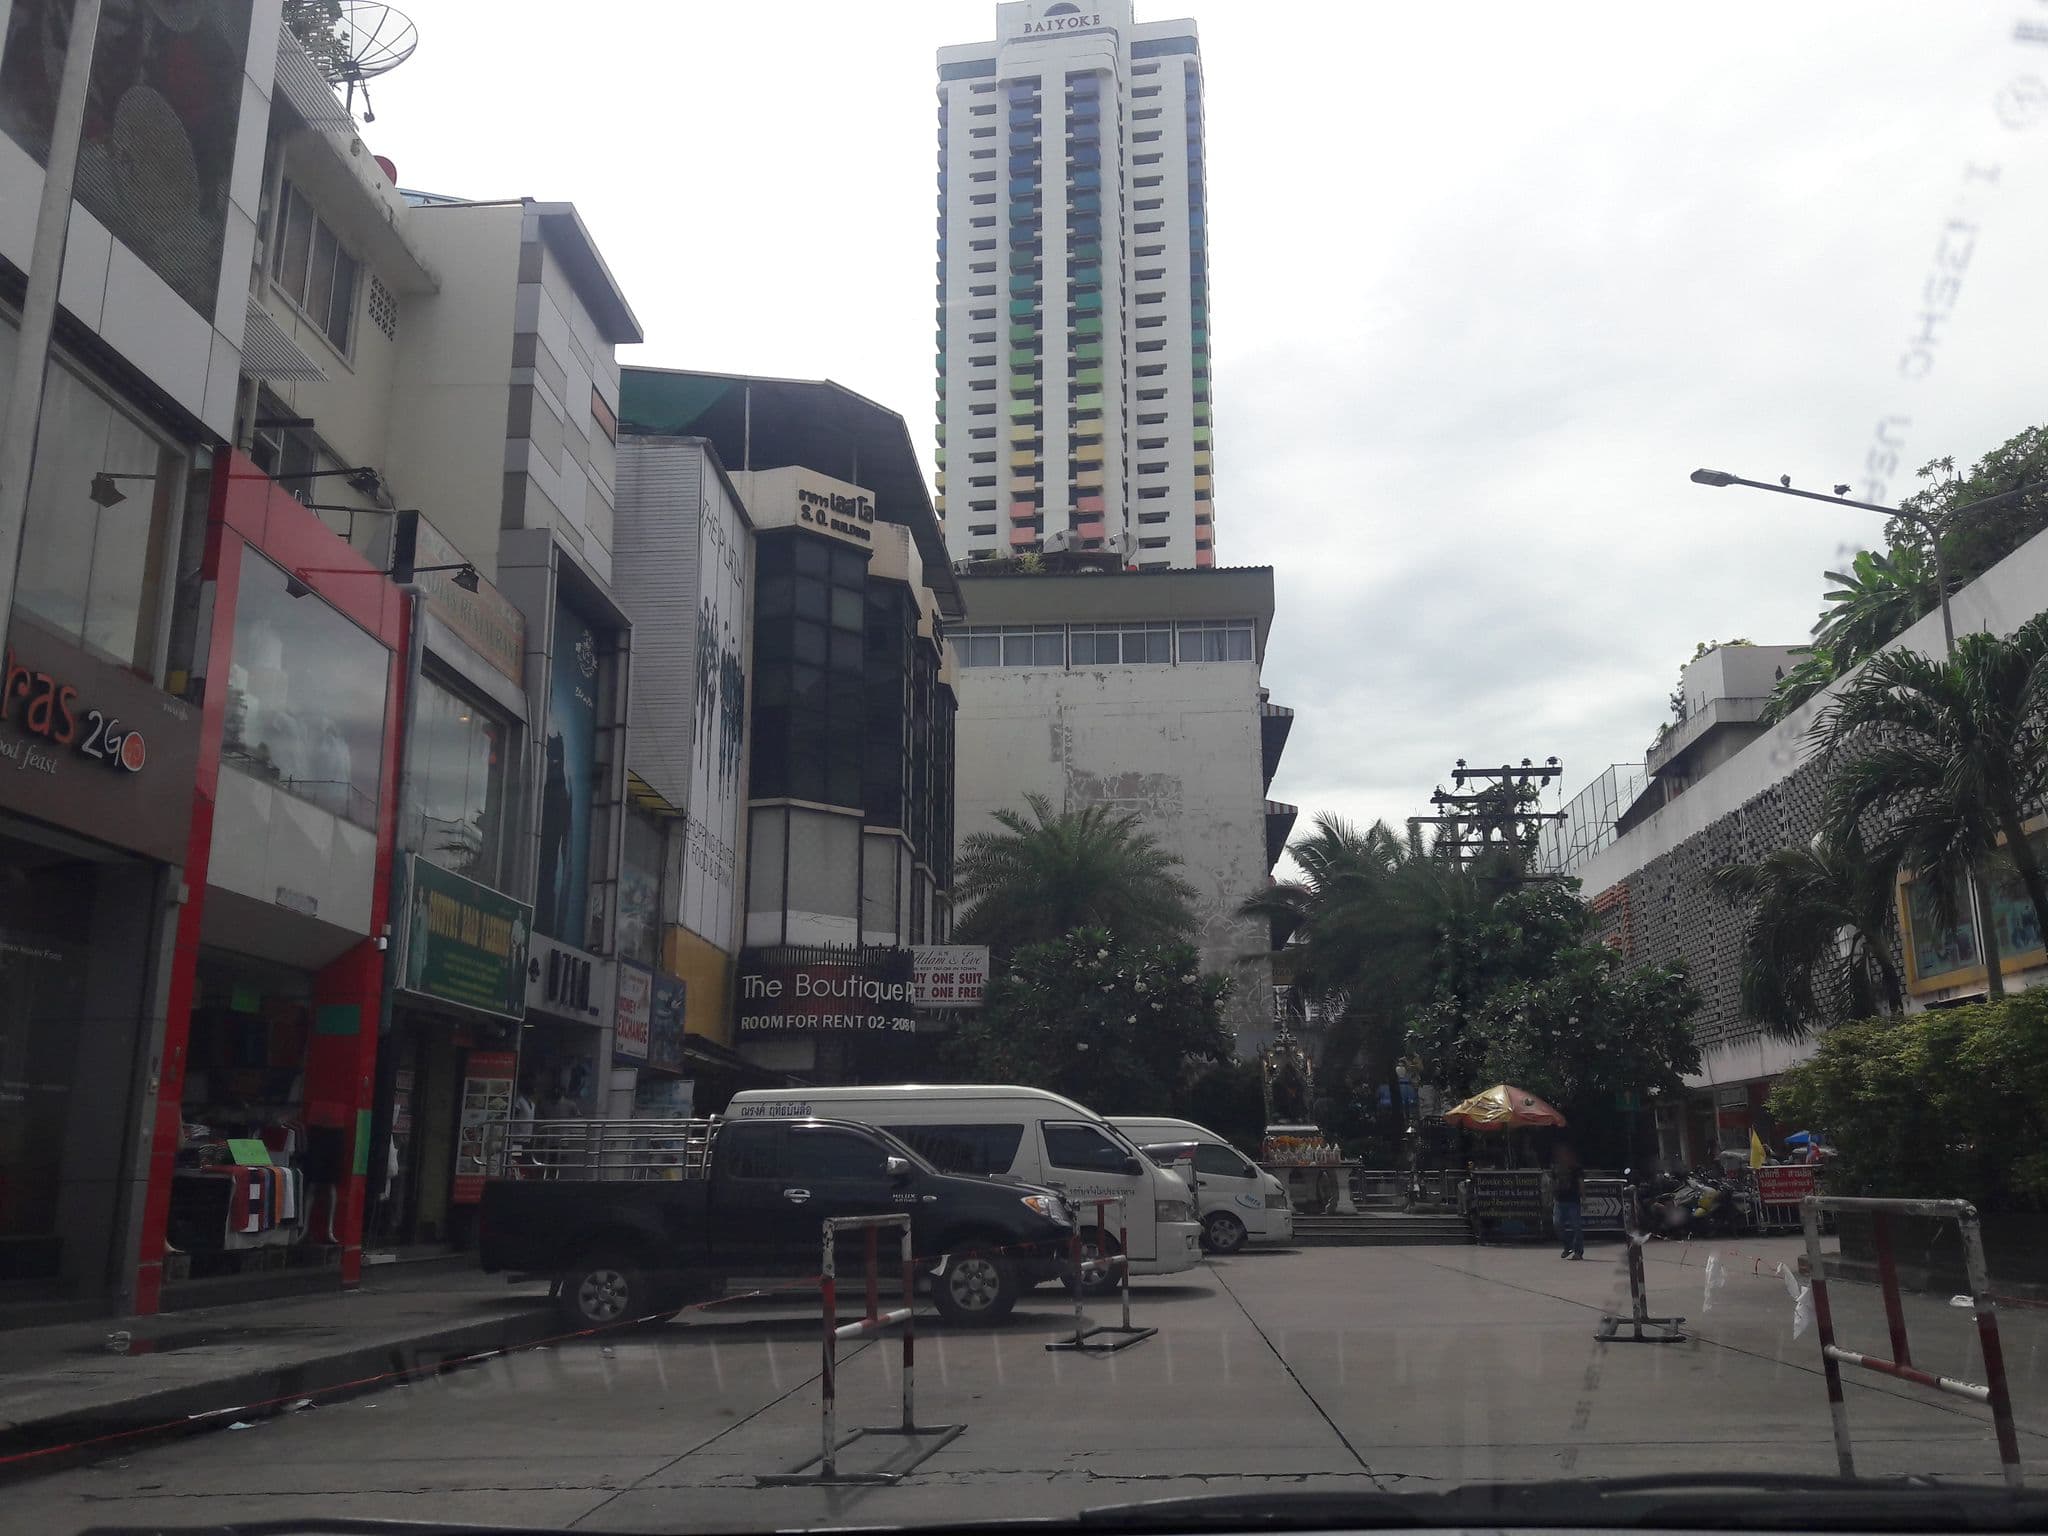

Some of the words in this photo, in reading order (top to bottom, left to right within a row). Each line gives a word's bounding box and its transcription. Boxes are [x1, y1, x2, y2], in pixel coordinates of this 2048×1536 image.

[1004, 14, 1101, 34] BAIYOKE
[18, 745, 58, 775] feast
[742, 974, 783, 999] The
[912, 973, 927, 984] UY
[932, 973, 954, 984] ONE
[959, 973, 983, 984] SUIT
[931, 986, 954, 998] ONE
[958, 986, 984, 998] FREE
[741, 1015, 783, 1030] ROOM
[786, 1014, 818, 1028] FOR
[822, 1014, 864, 1029] RENT
